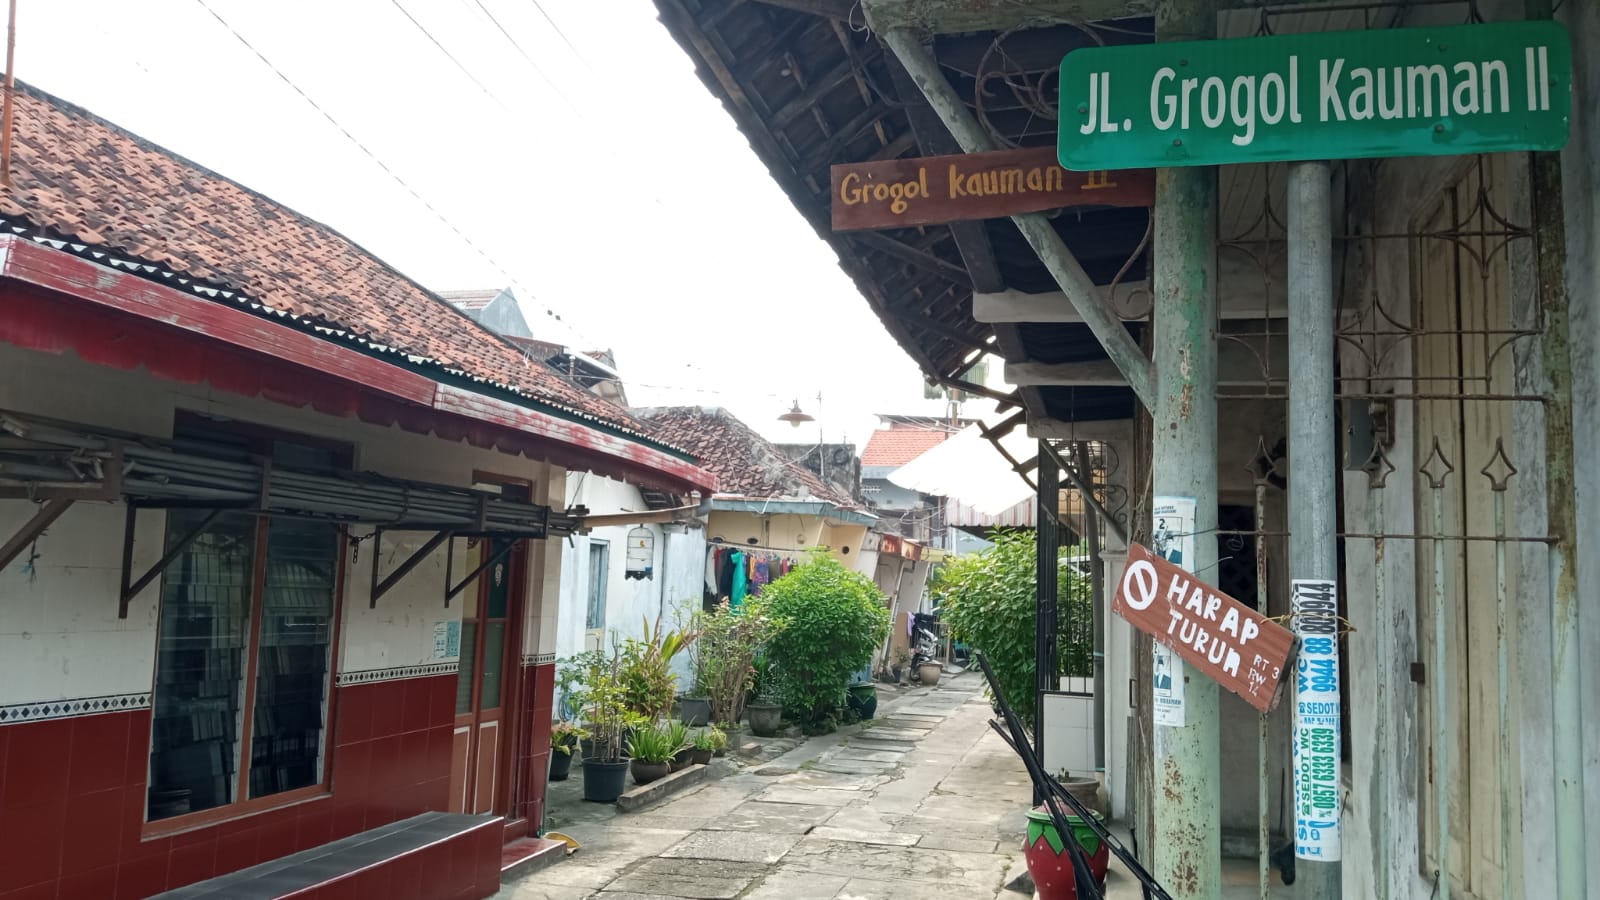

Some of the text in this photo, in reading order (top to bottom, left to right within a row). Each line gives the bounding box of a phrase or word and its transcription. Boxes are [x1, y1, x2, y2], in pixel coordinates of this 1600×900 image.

[1079, 46, 1551, 146] JL. Grogol Kauman II
[840, 167, 930, 214] Grogol
[949, 164, 1063, 199] kauman
[1158, 518, 1166, 530] 2
[1167, 574, 1259, 645] HARAP
[1167, 608, 1241, 678] TURUN
[1304, 637, 1332, 655] 88
[1247, 667, 1266, 685] RW
[1253, 654, 1280, 680] RT 3
[1310, 658, 1337, 693] 9944
[1306, 702, 1335, 714] SEDOT
[1311, 727, 1335, 753] 6339
[1300, 727, 1310, 802] SEDOT WC
[1312, 755, 1335, 781] 6333
[1312, 783, 1336, 809] 0857
